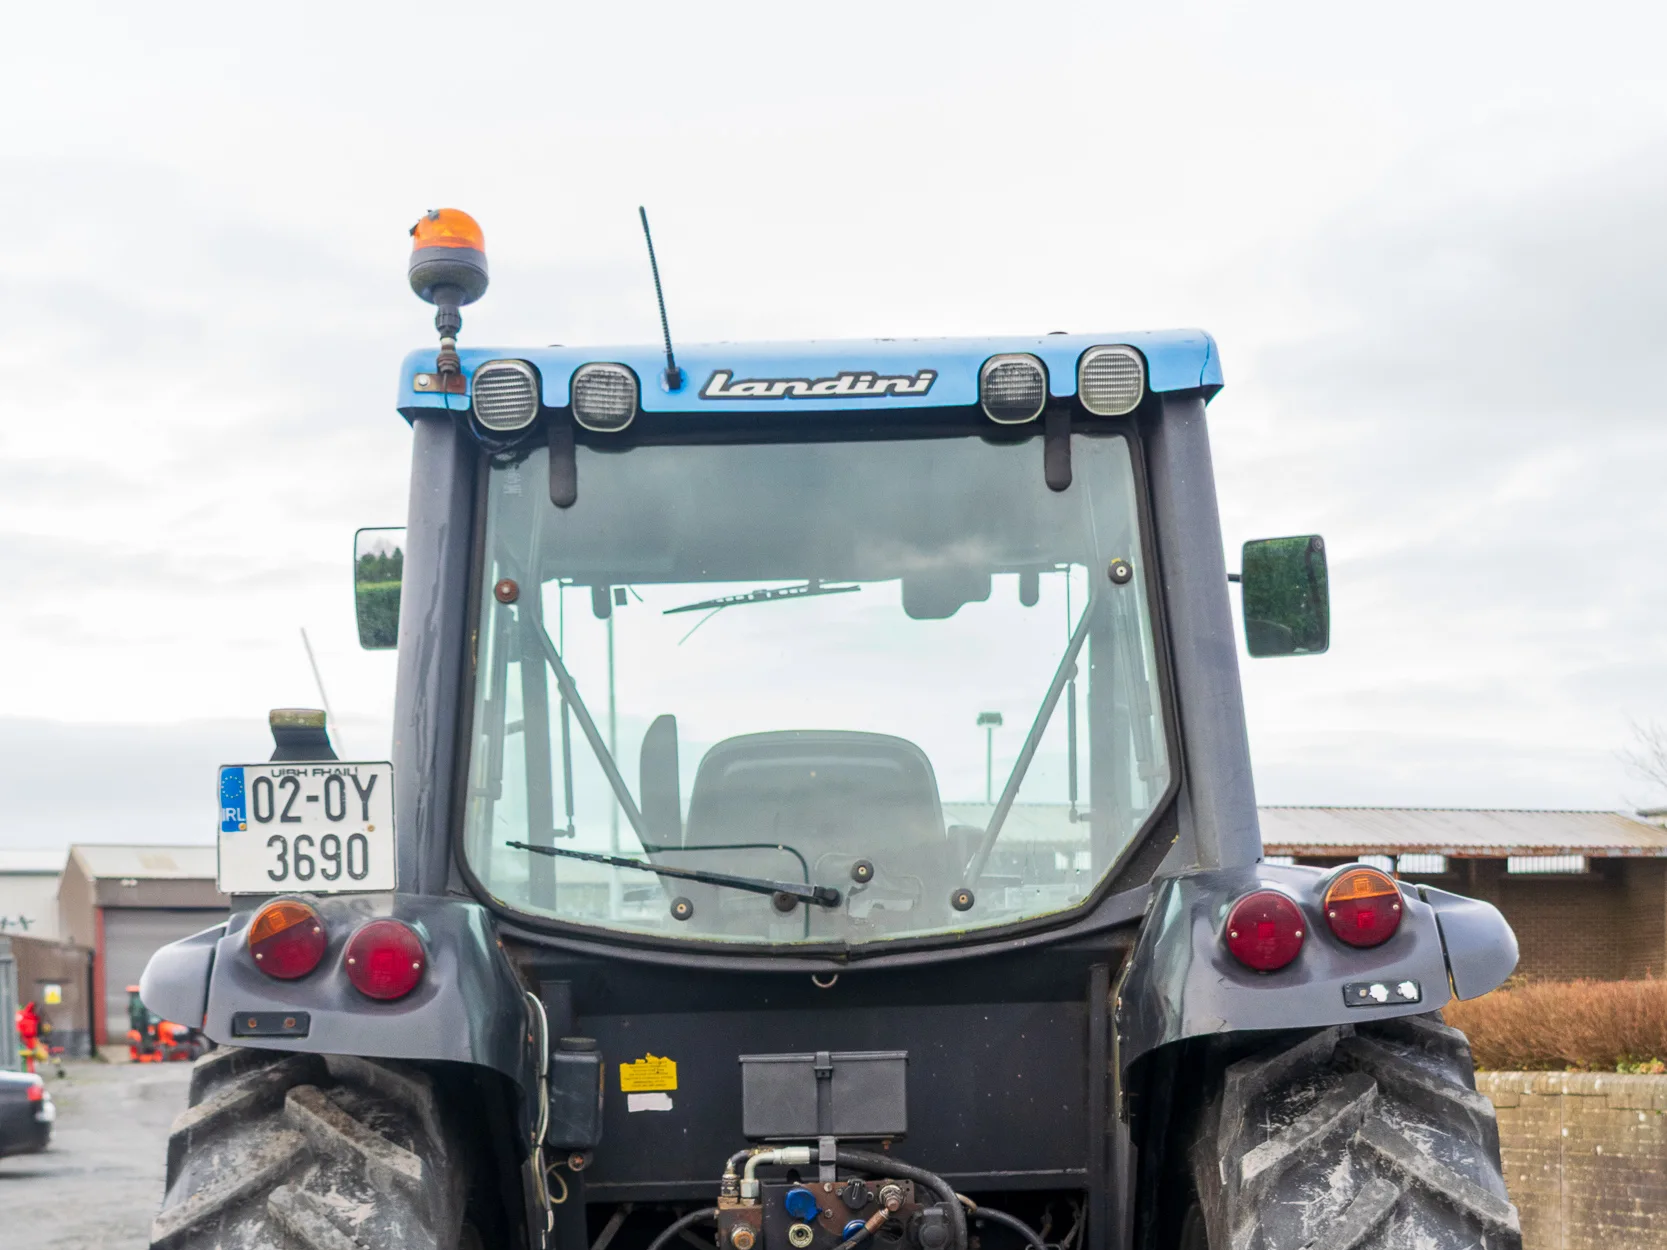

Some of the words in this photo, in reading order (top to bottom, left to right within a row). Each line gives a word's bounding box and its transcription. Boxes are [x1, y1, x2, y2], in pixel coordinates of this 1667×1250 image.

[700, 370, 937, 399] Landini
[222, 807, 246, 821] IRL
[267, 833, 368, 881] 3690
